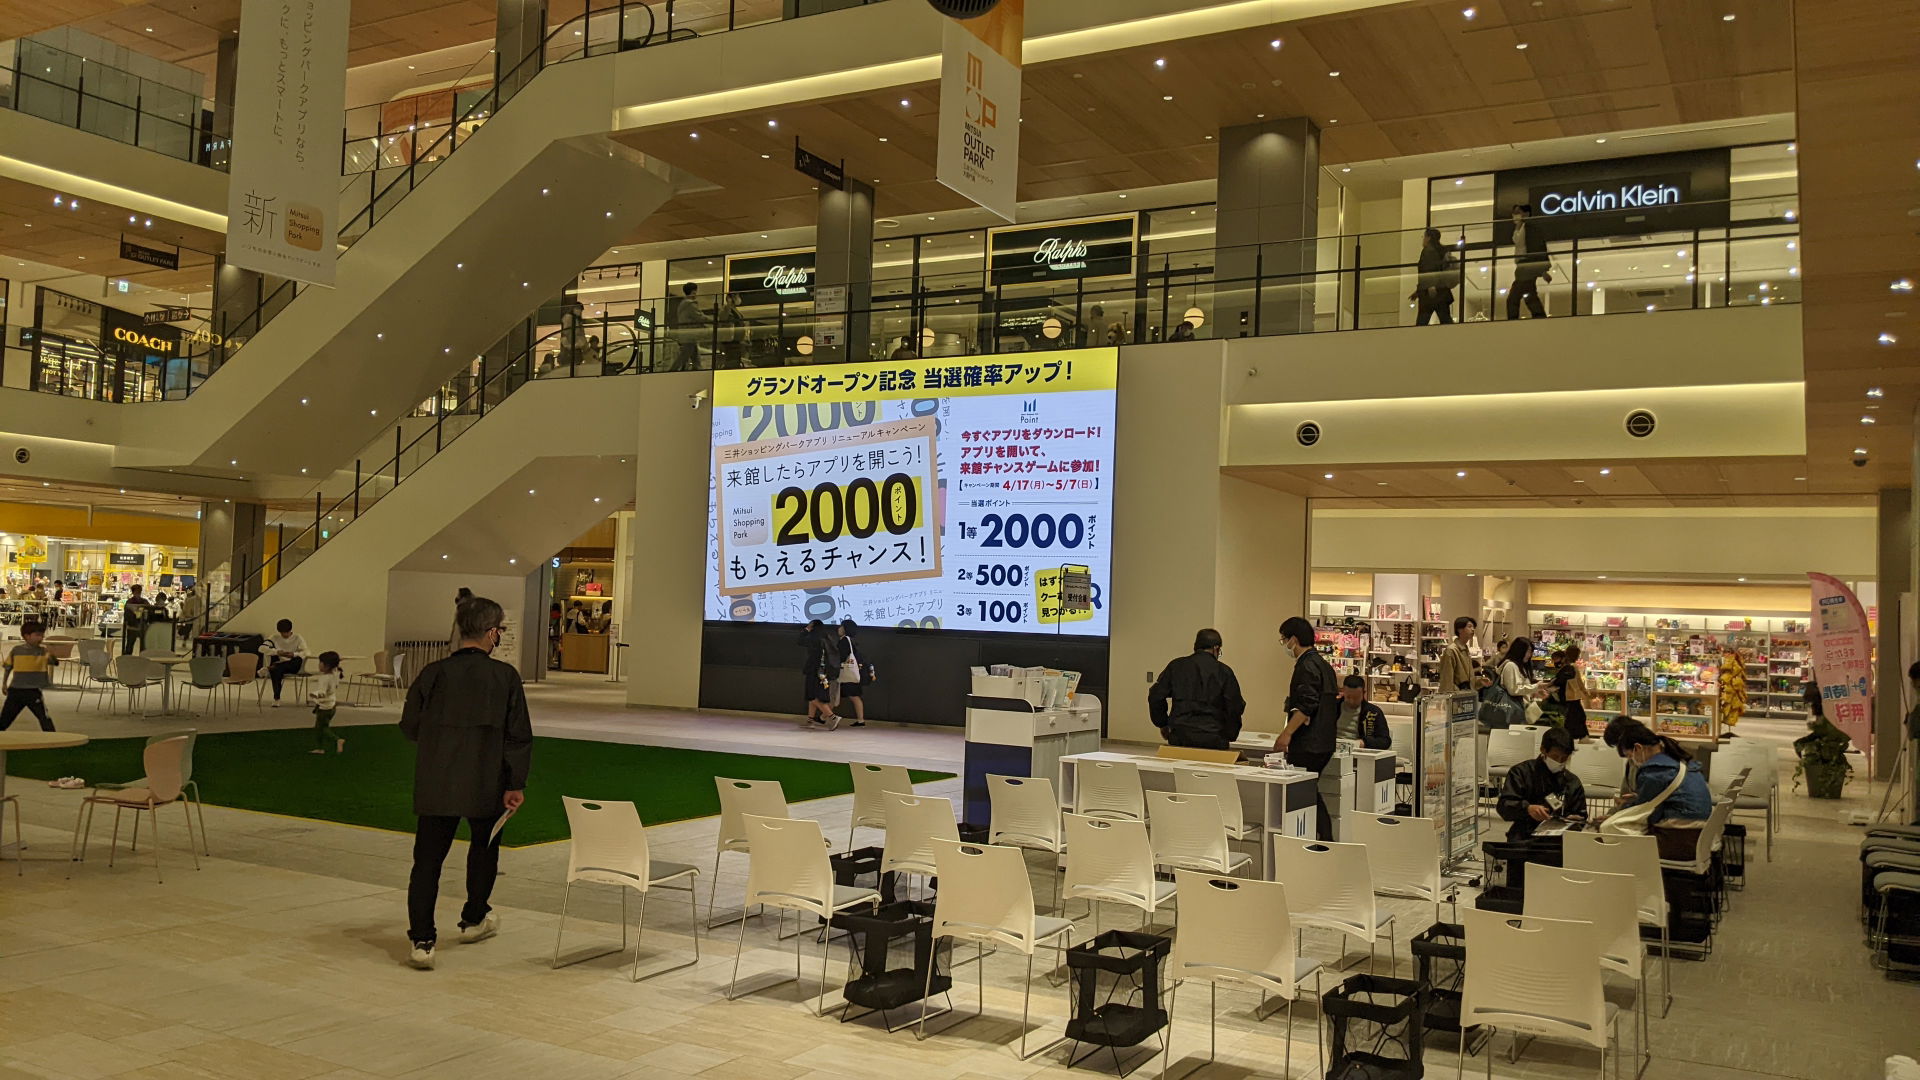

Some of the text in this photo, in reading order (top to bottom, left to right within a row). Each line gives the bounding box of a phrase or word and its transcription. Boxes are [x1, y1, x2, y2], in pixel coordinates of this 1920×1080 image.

[964, 132, 996, 161] OUTLET
[963, 147, 985, 171] PARK
[1540, 184, 1679, 215] Calvin Klein
[242, 189, 278, 239] 新
[289, 208, 310, 220] Mitsui
[288, 218, 321, 236] Shopping
[288, 229, 303, 240] Park
[114, 327, 173, 353] COACH
[746, 361, 1073, 397] グランドオープン記念 当選確率アップ！
[1020, 416, 1039, 424] Point
[724, 423, 926, 459] 三井ショッピングパークアプリ リニューアルキャンペーン
[961, 445, 1046, 458] アプリを開いて、
[733, 506, 753, 515] Mitsui
[775, 472, 917, 546] 2000
[893, 485, 903, 524] ポイント
[971, 499, 1011, 508] 当選ポイント
[733, 517, 765, 528] Shopping
[733, 530, 749, 539] Park
[958, 513, 1084, 549] 1等 2000
[1088, 514, 1097, 550] ポイント
[729, 535, 927, 580] もらえるチャンス！
[957, 564, 1023, 587] 2等 500
[863, 598, 944, 622] 来館したらアプリ
[956, 600, 1022, 623] 3等 100
